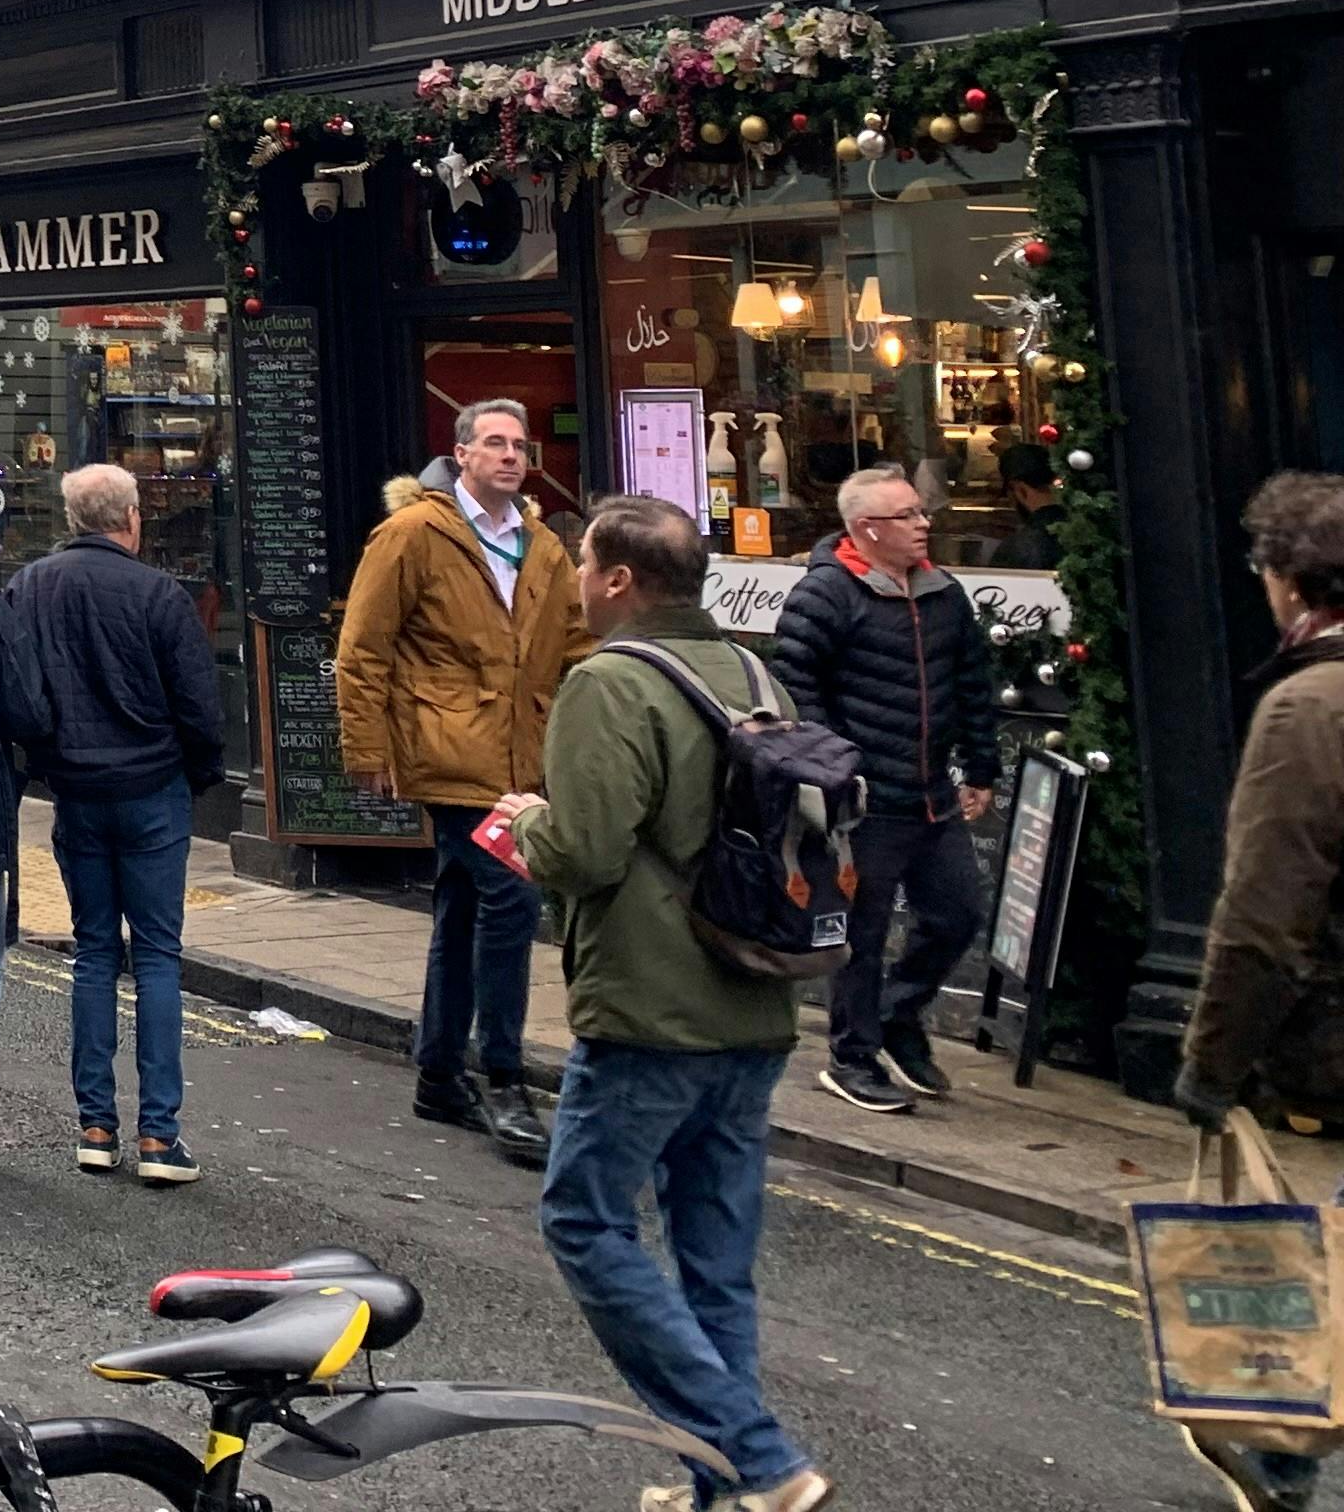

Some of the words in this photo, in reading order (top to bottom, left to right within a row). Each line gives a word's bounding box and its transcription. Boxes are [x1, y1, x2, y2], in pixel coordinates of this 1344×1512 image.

[263, 332, 309, 353] Vegan
[704, 571, 785, 626] Coffee
[973, 585, 1061, 628] Beer
